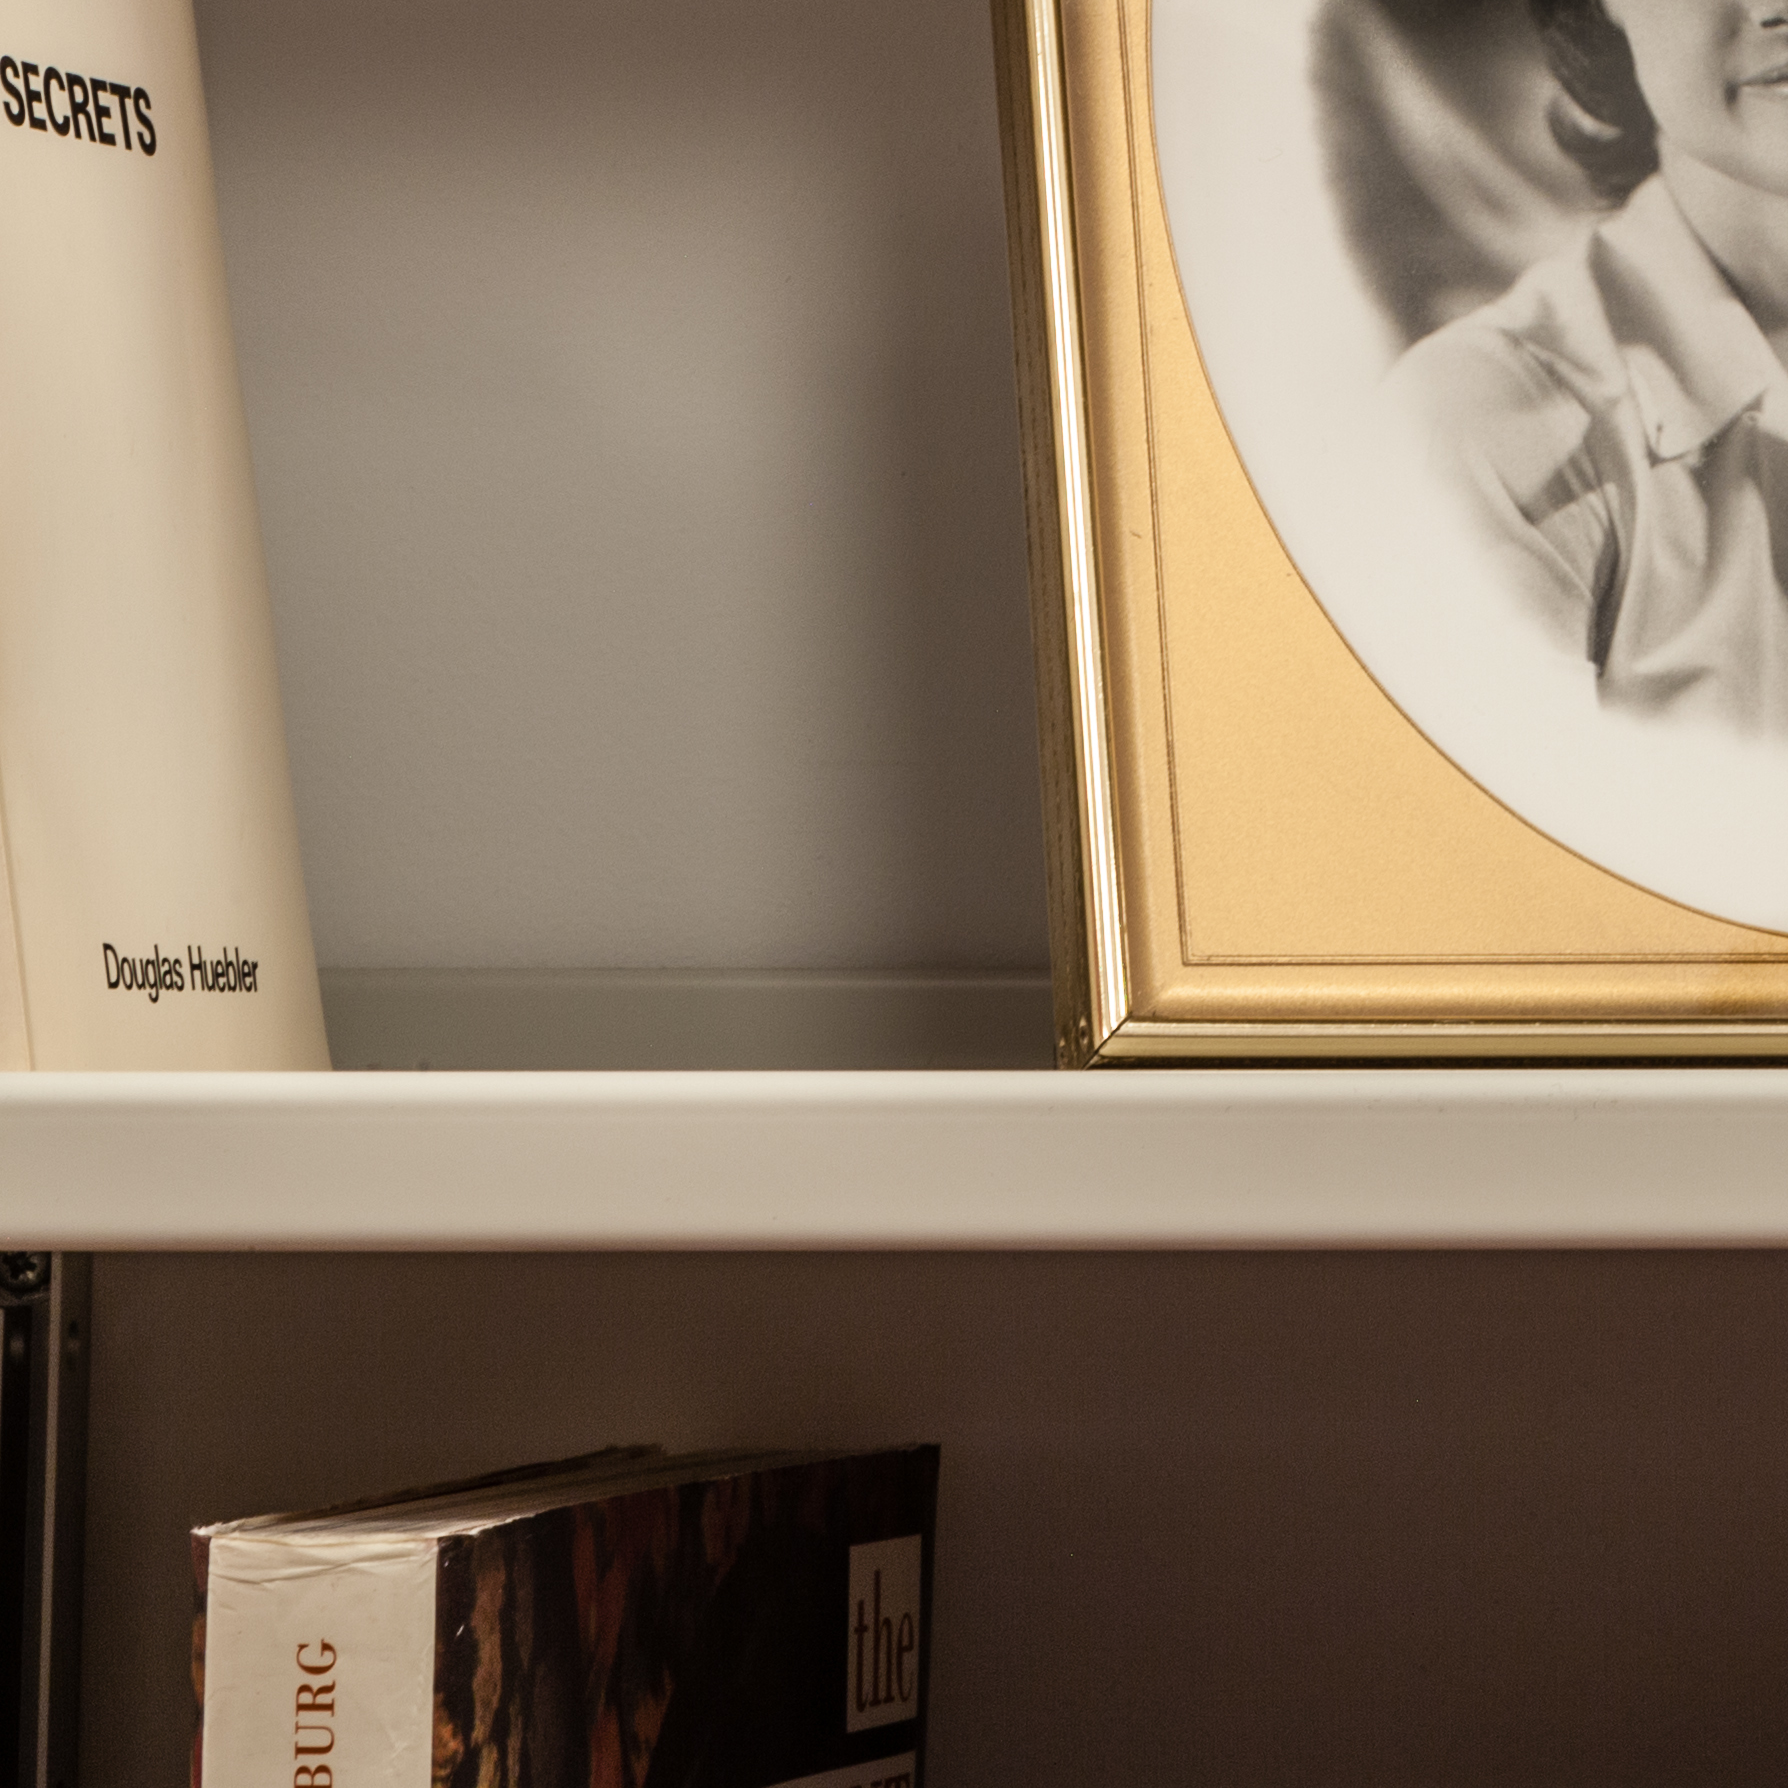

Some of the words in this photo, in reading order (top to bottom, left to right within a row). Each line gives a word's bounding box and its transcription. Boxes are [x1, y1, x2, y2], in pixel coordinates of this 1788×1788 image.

[0, 55, 158, 157] SECRETS
[102, 942, 185, 1004] Douglas
[187, 944, 259, 993] Huebler
[853, 1568, 916, 1713] the
[294, 1638, 337, 1788] BURG
